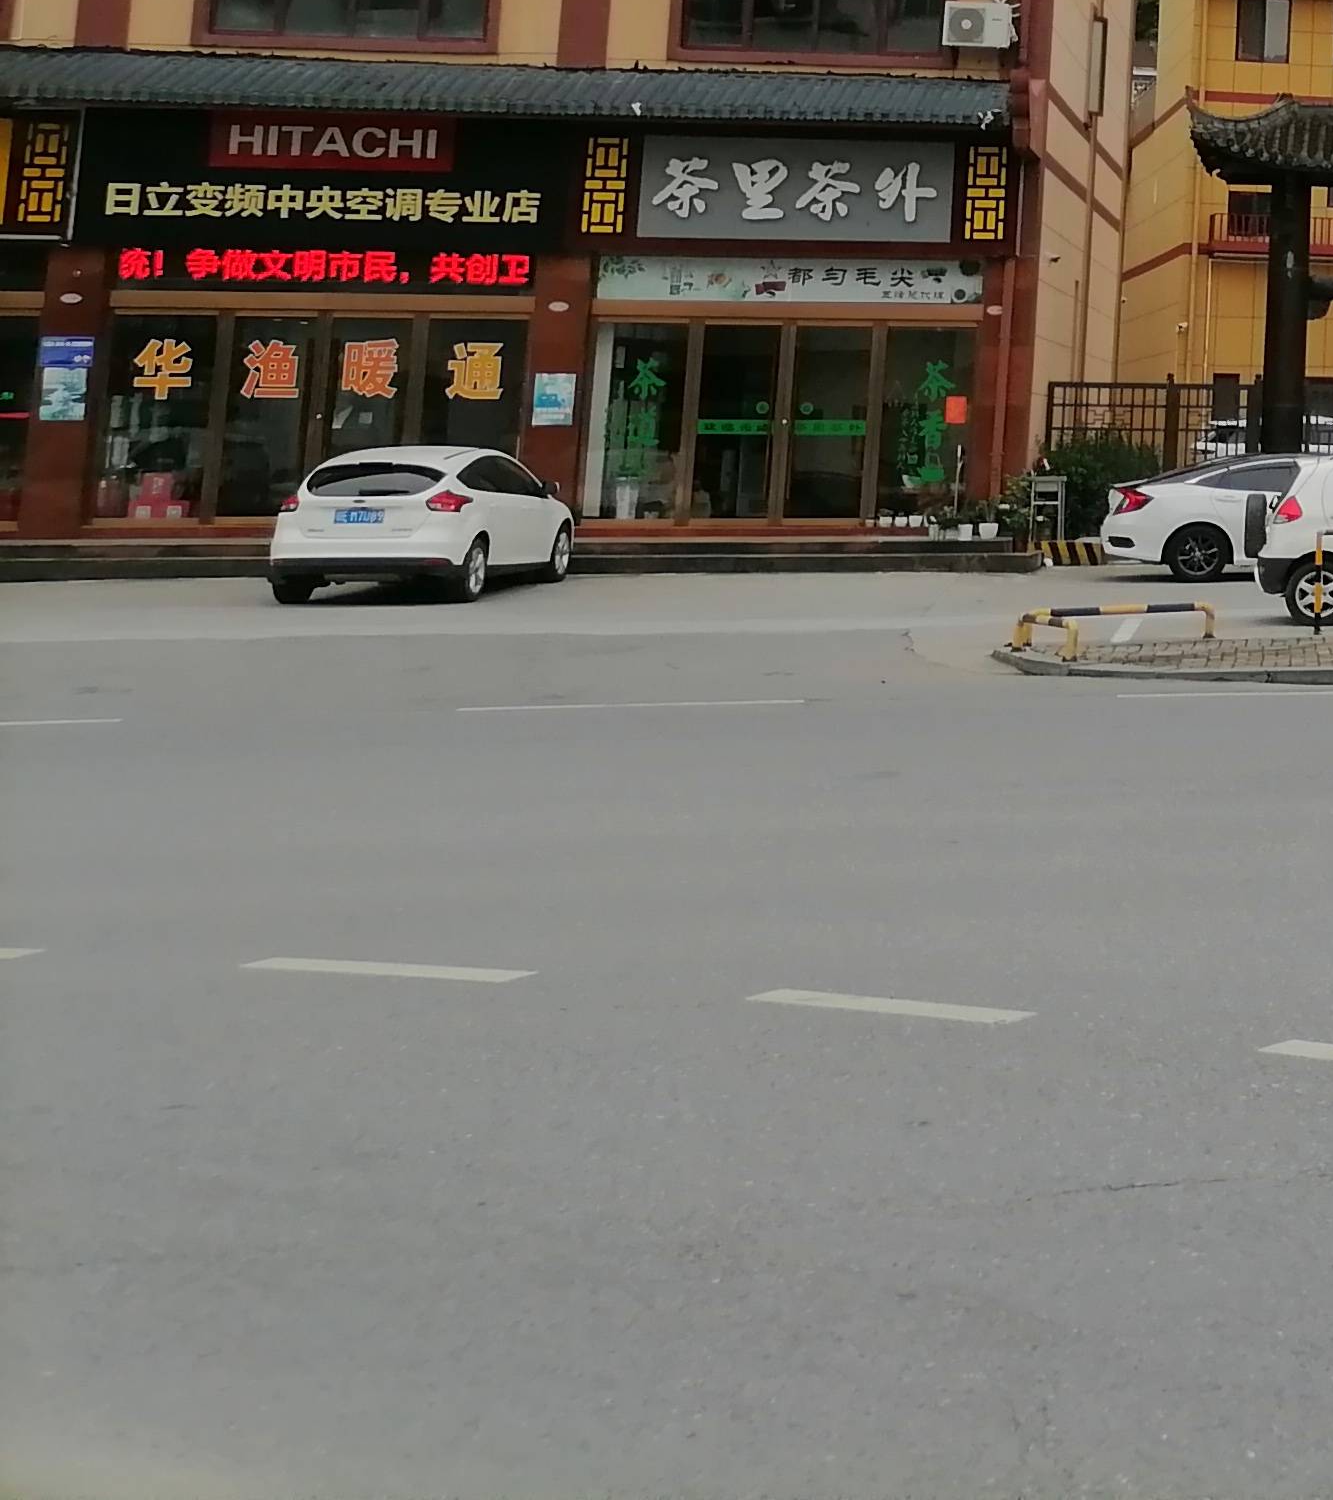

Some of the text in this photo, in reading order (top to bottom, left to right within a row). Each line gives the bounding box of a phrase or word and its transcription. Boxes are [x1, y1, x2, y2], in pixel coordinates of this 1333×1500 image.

[228, 125, 437, 159] HITACHI
[105, 182, 541, 223] 日立变频中央空调专业店
[652, 157, 937, 222] 茶里茶外
[787, 266, 914, 288] 都匀毛尖
[133, 338, 505, 400] 华渔暖通
